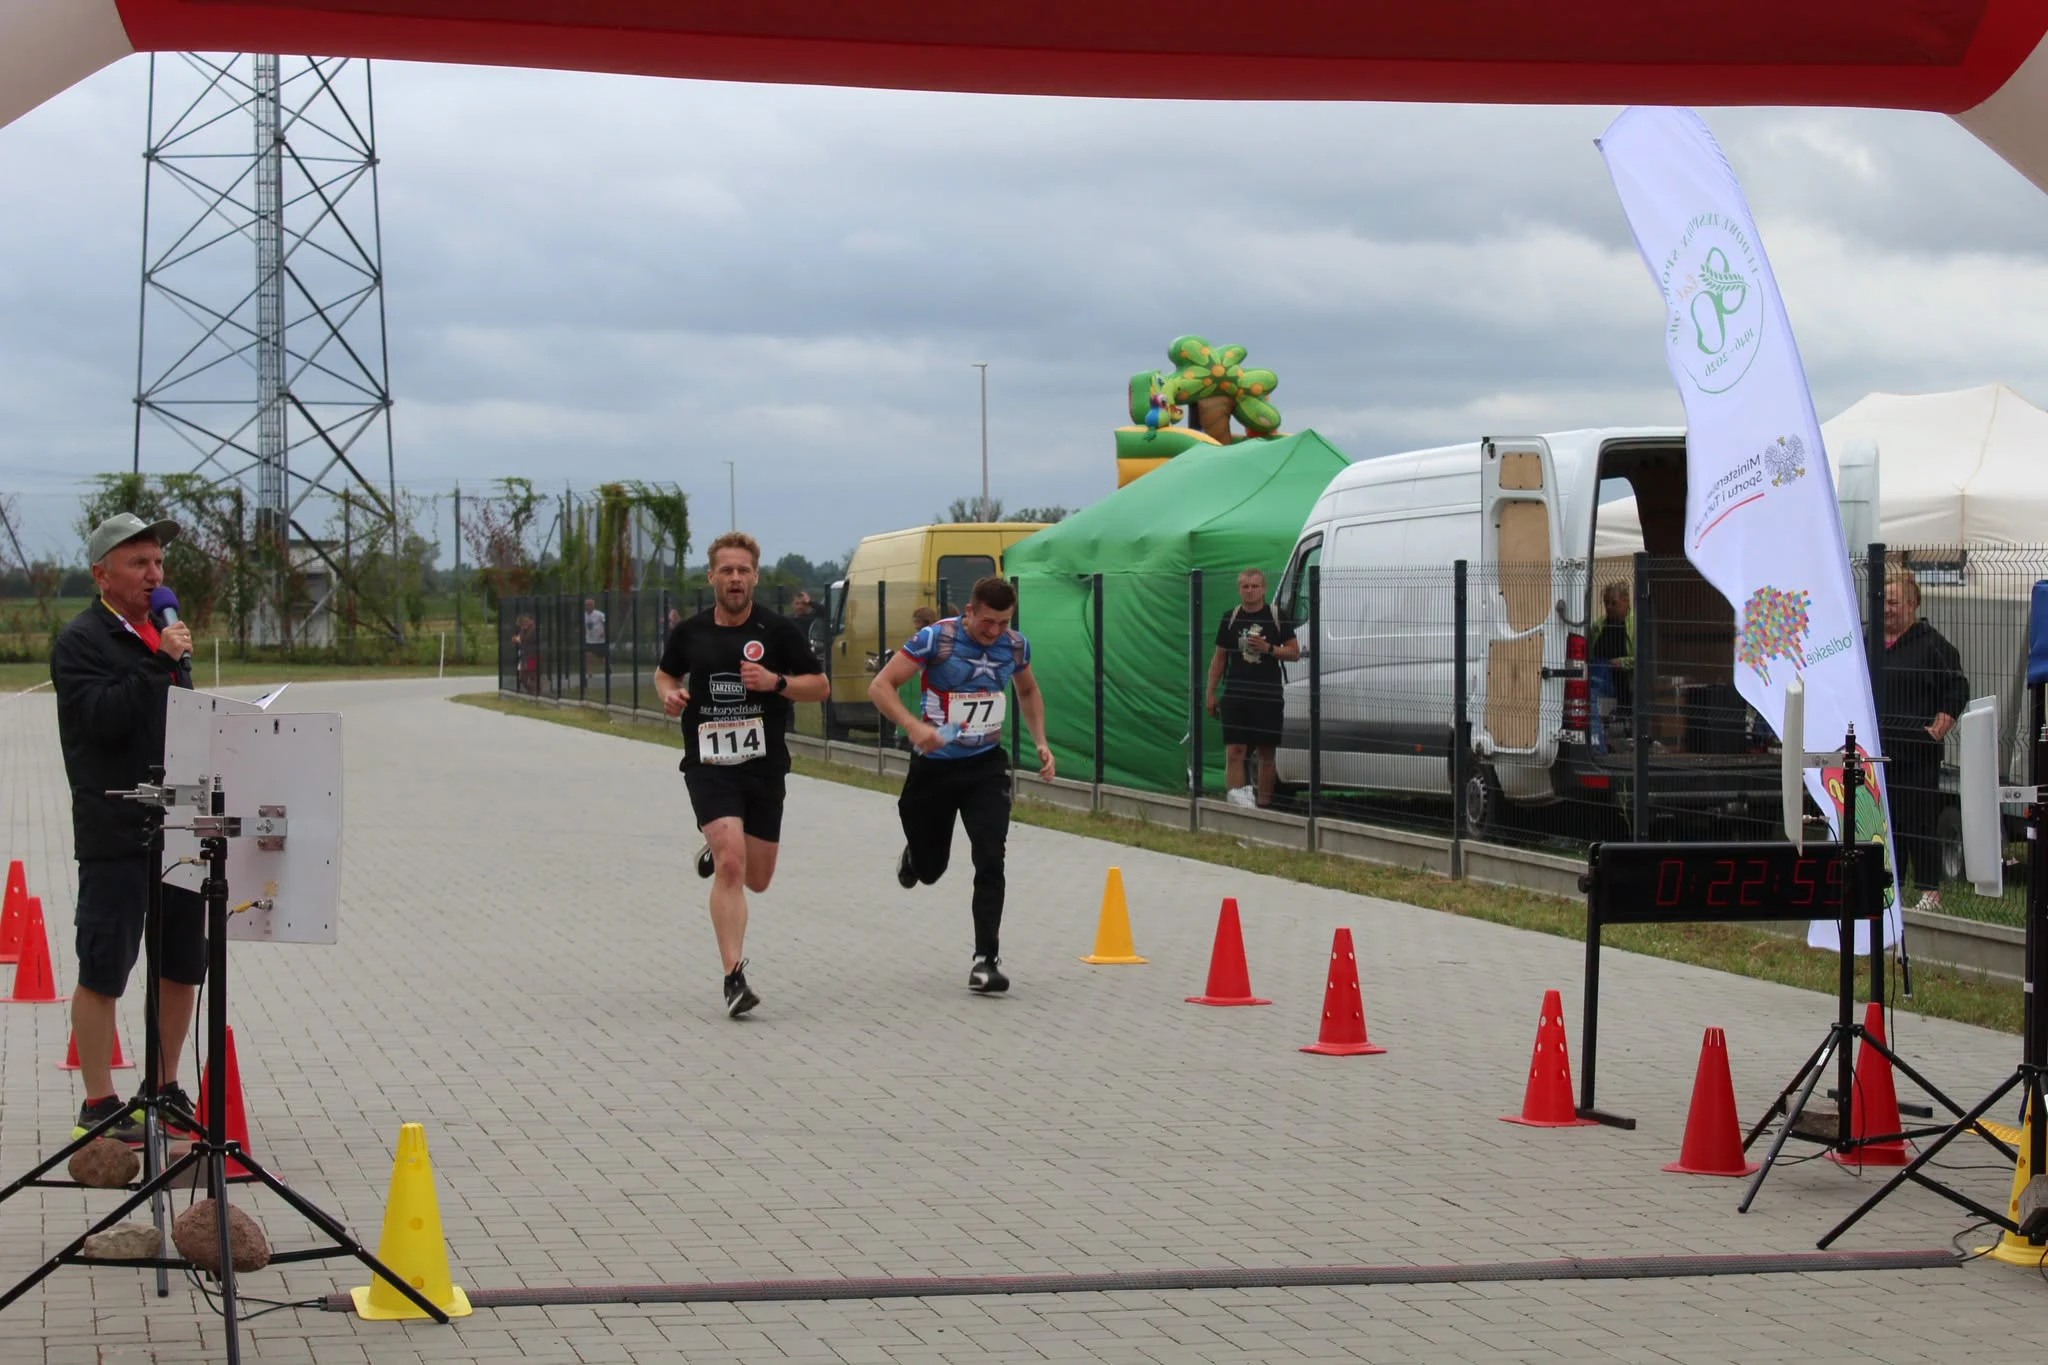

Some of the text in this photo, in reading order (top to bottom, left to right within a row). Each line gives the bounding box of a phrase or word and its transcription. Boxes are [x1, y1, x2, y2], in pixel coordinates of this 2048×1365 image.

[712, 683, 744, 694] ZARZECCY
[963, 700, 994, 724] 77
[707, 728, 760, 755] 114
